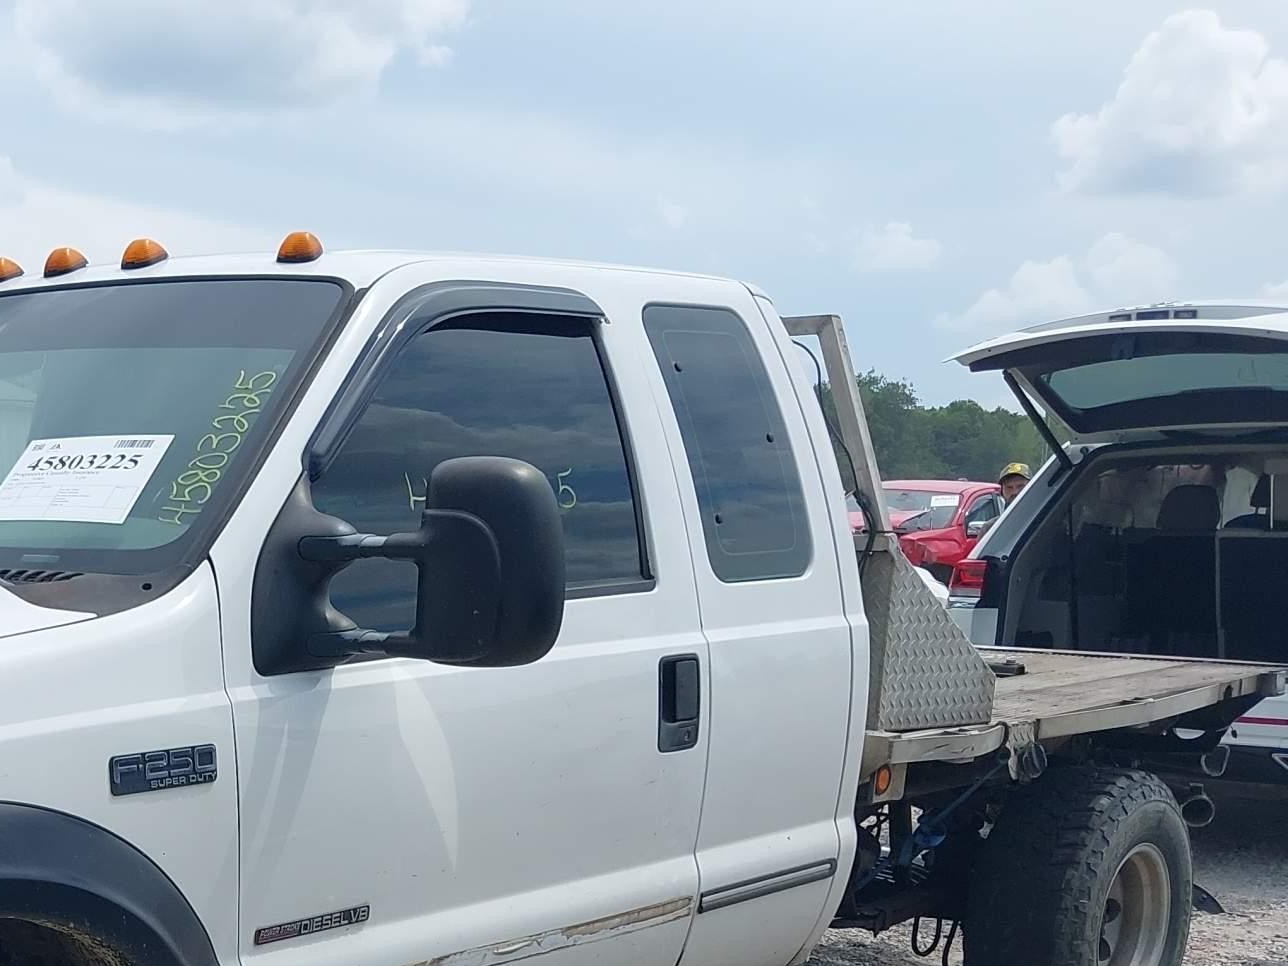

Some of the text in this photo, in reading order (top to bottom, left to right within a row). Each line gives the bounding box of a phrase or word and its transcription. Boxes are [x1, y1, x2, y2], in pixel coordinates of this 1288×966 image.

[158, 369, 276, 525] 45803225
[26, 453, 144, 472] 45803225
[150, 771, 217, 789] SUPER DUTY
[300, 912, 349, 934] DIESEL
[349, 906, 369, 922] V8
